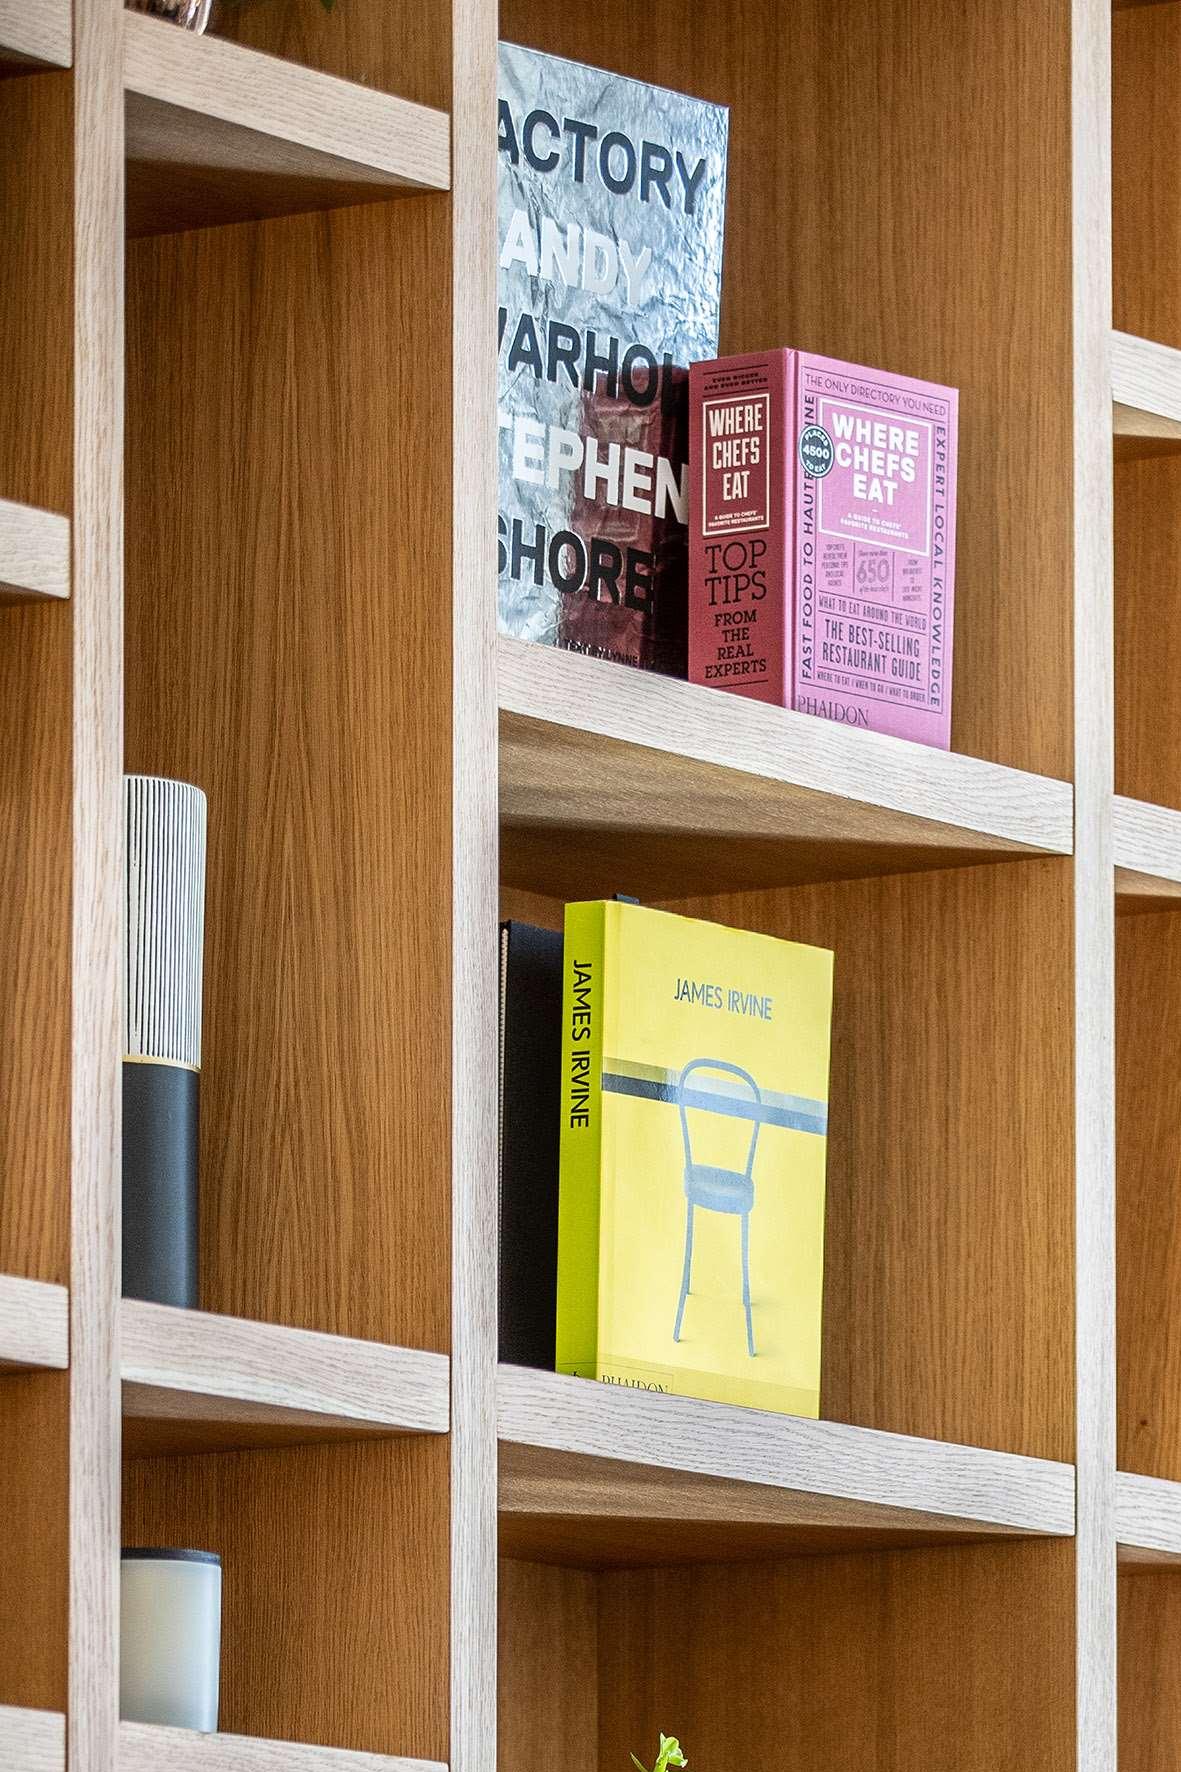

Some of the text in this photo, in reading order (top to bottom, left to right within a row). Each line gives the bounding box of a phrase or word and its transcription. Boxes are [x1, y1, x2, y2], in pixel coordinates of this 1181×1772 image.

[500, 209, 651, 305] ANDY
[805, 373, 946, 417] THE ONLY DIRECTORY YOU NEED
[709, 403, 763, 437] WHERE
[832, 412, 920, 457] WHERE
[712, 437, 760, 469] CHEFS
[803, 444, 830, 459] 4500
[804, 431, 829, 447] PLACES
[805, 459, 827, 474] TO EAT
[835, 443, 916, 483] CHEFS
[723, 471, 750, 501] EAT
[853, 474, 898, 505] EAT
[803, 472, 814, 535] HAUTE
[705, 539, 767, 573] TOP
[803, 543, 813, 566] TO
[857, 558, 890, 584] 650
[930, 426, 946, 706] EXPERT LOCAL KNOWLEDGE
[705, 570, 767, 606] TIPS
[803, 574, 813, 627] FOOD
[714, 609, 757, 627] FROM
[819, 594, 927, 631] WHAT TO EAT AROUND THE WORLD
[717, 643, 754, 660] REAL
[721, 627, 749, 642] THE
[825, 618, 920, 658] THE BEST-SELLING
[705, 658, 767, 679] EXPERTS
[802, 635, 812, 679] FAST
[823, 642, 921, 682] RESTAURANT GUIDE
[817, 670, 834, 683] WHERE
[834, 673, 841, 685] TO
[841, 675, 850, 687] EAT
[855, 679, 869, 690] WHEN
[870, 681, 877, 692] TO
[878, 683, 884, 694] GO
[903, 687, 909, 699] TO
[797, 695, 869, 726] PHAIDON
[673, 978, 773, 1021] JAMES IRVINE
[569, 960, 593, 1129] JAMES IRVINE
